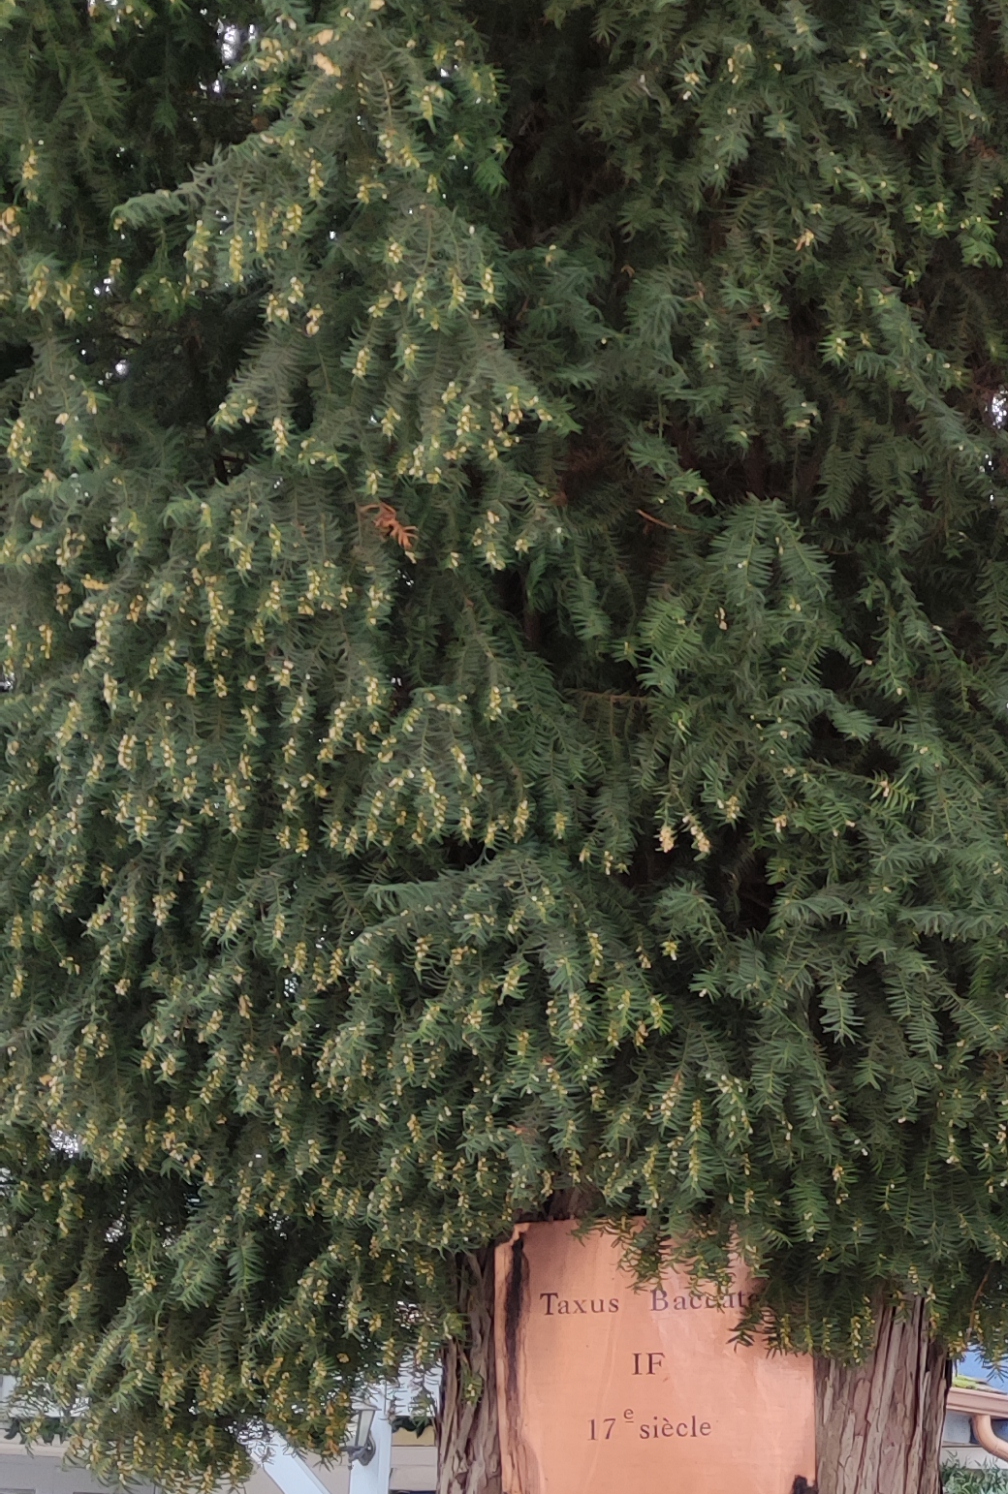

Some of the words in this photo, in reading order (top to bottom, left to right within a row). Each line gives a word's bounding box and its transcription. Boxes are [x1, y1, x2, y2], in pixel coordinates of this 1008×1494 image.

[539, 1292, 620, 1315] Taxus
[631, 1352, 666, 1375] IF
[639, 1415, 712, 1439] siècle
